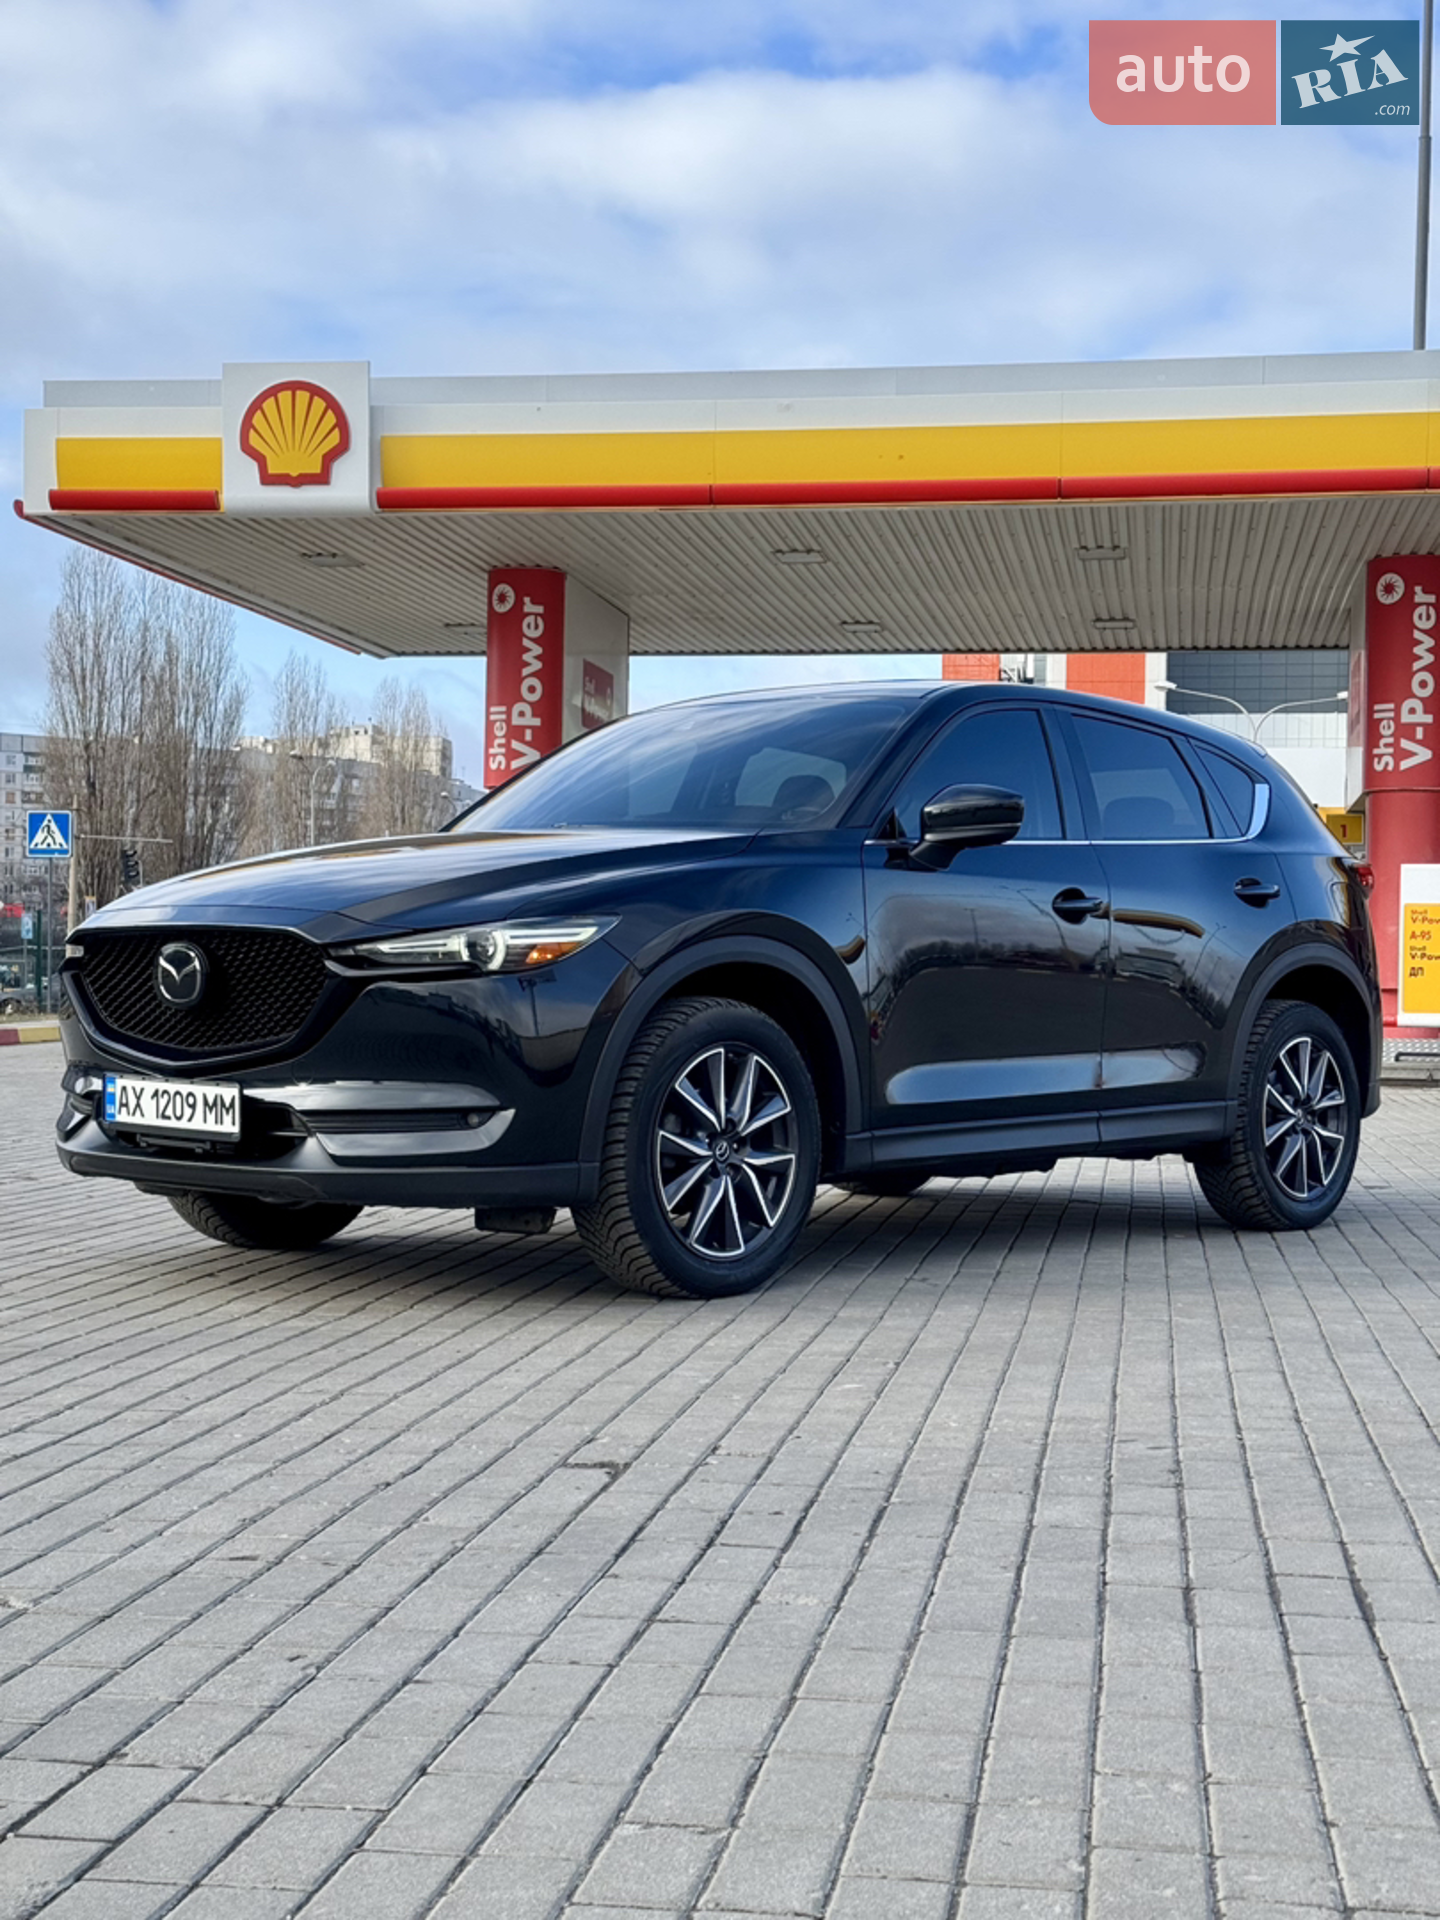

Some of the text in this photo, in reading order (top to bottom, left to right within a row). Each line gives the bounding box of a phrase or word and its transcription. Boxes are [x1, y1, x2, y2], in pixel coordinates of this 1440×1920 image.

[510, 596, 545, 770] V-Power
[1399, 585, 1437, 772] V-Power
[488, 705, 508, 771] Shell
[1372, 703, 1396, 772] Shell
[1340, 824, 1348, 838] 1
[118, 1086, 236, 1127] AX 1209 MM
